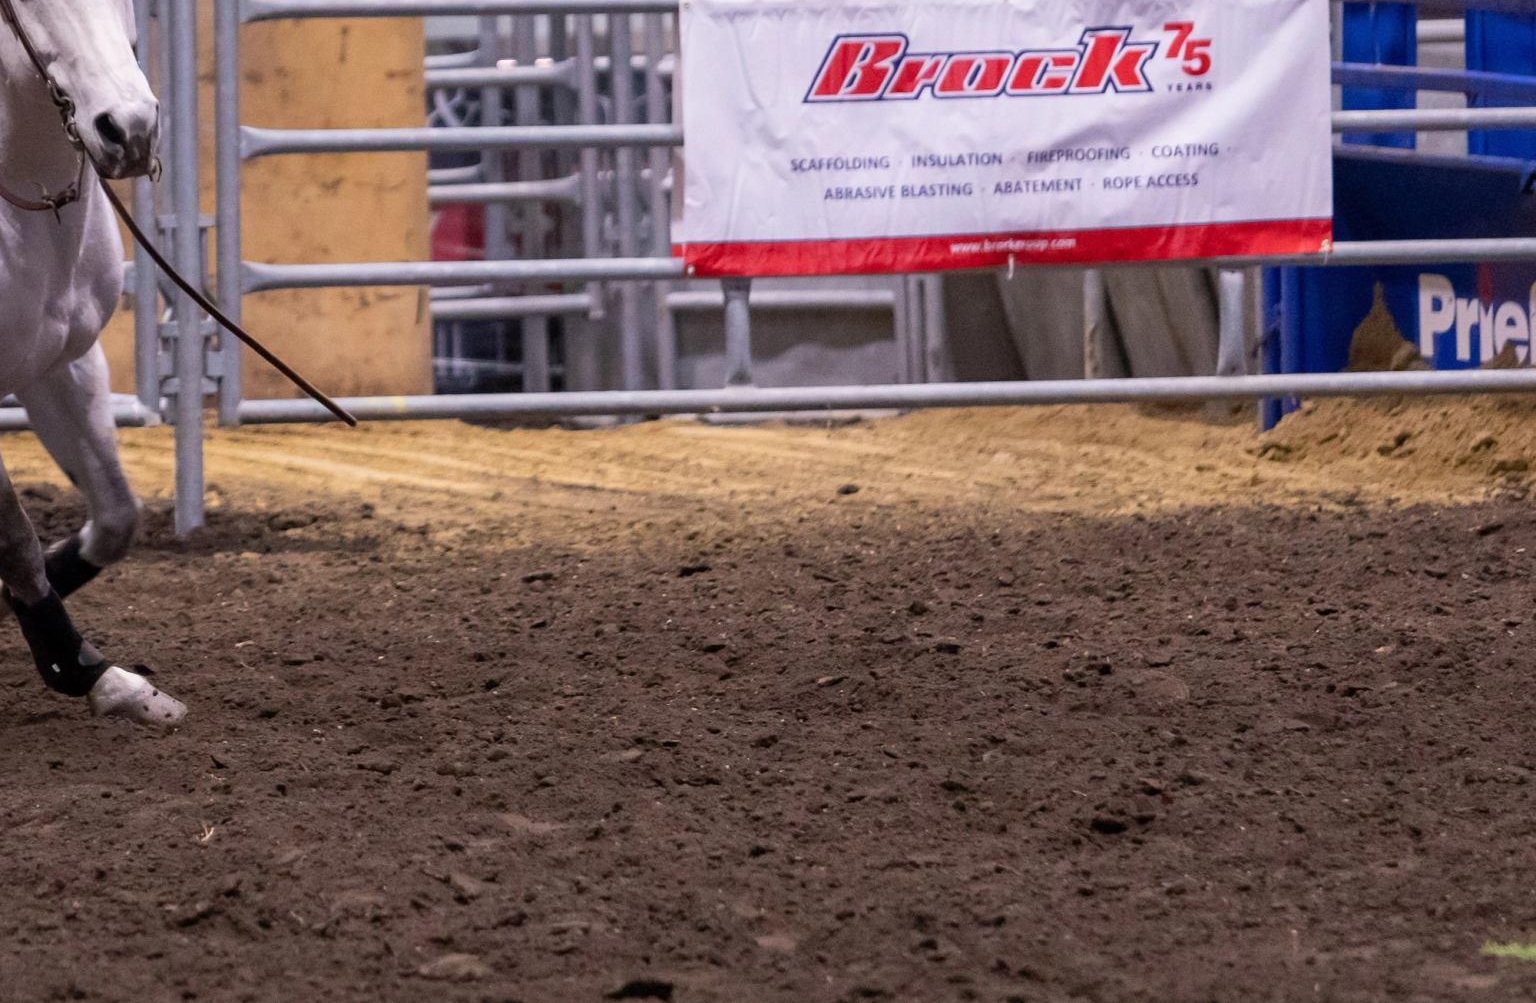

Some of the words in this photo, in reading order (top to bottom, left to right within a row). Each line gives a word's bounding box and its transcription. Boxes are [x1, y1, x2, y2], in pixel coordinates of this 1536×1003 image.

[802, 25, 1160, 103] Brock
[1164, 21, 1212, 76] 75
[1167, 81, 1213, 93] YEARS
[791, 156, 890, 172] SCAFFOLDING
[911, 152, 1003, 168] INSULATION
[1027, 147, 1131, 164] FIREPROOFING
[1151, 142, 1220, 158] COATING
[824, 185, 895, 200] ABRASIVE
[901, 183, 973, 197] BLASTING
[993, 178, 1082, 194] ABATEMENT
[1103, 175, 1142, 190] ROPE
[1146, 172, 1199, 188] ACCESS
